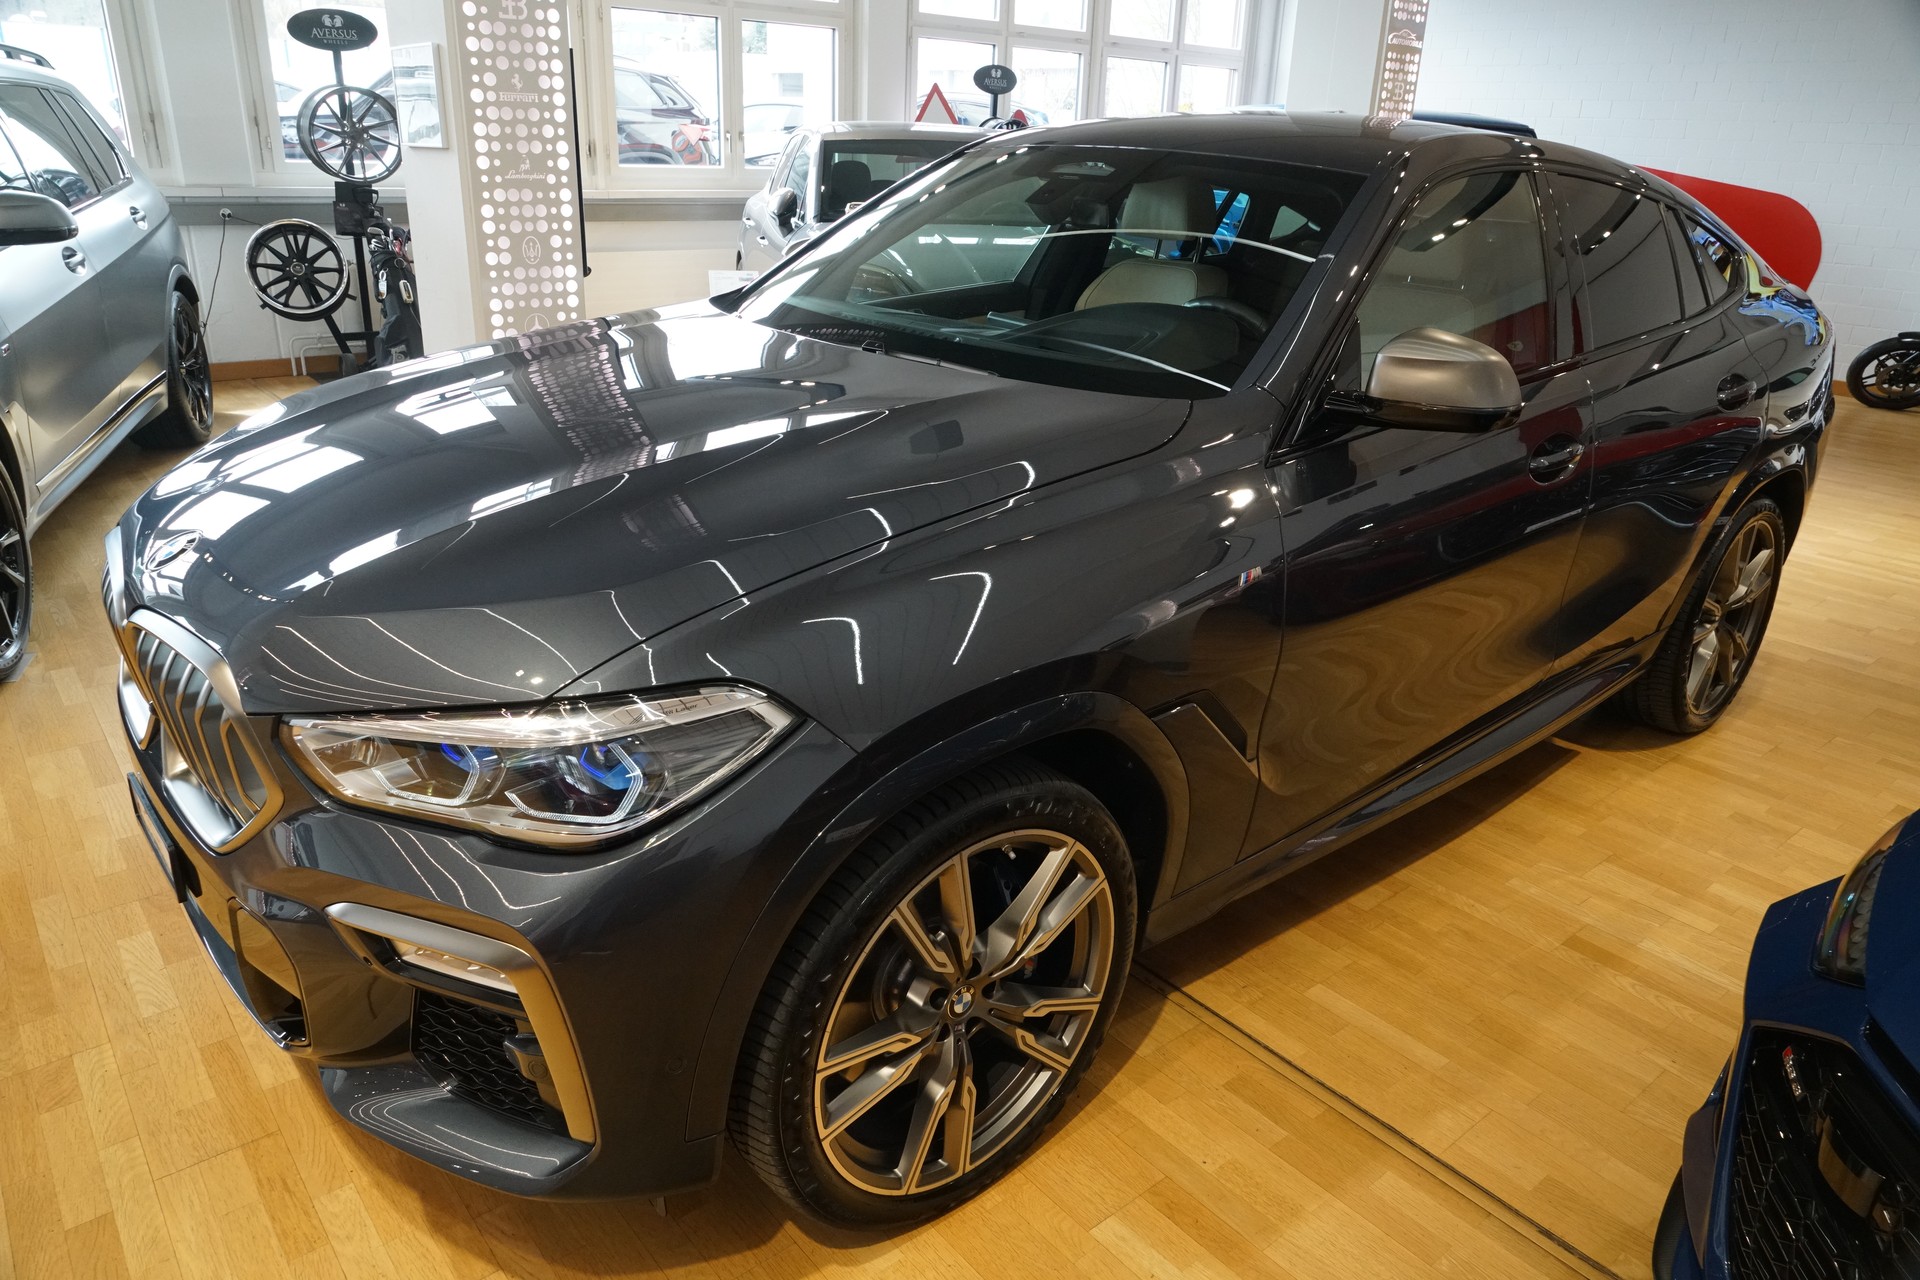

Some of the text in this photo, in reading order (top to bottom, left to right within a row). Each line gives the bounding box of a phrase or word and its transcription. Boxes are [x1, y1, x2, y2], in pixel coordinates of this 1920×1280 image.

[310, 27, 358, 40] AVERSUS
[984, 77, 1008, 87] AVERSUS
[499, 91, 539, 103] Ferrari
[504, 169, 546, 182] Lamborghini
